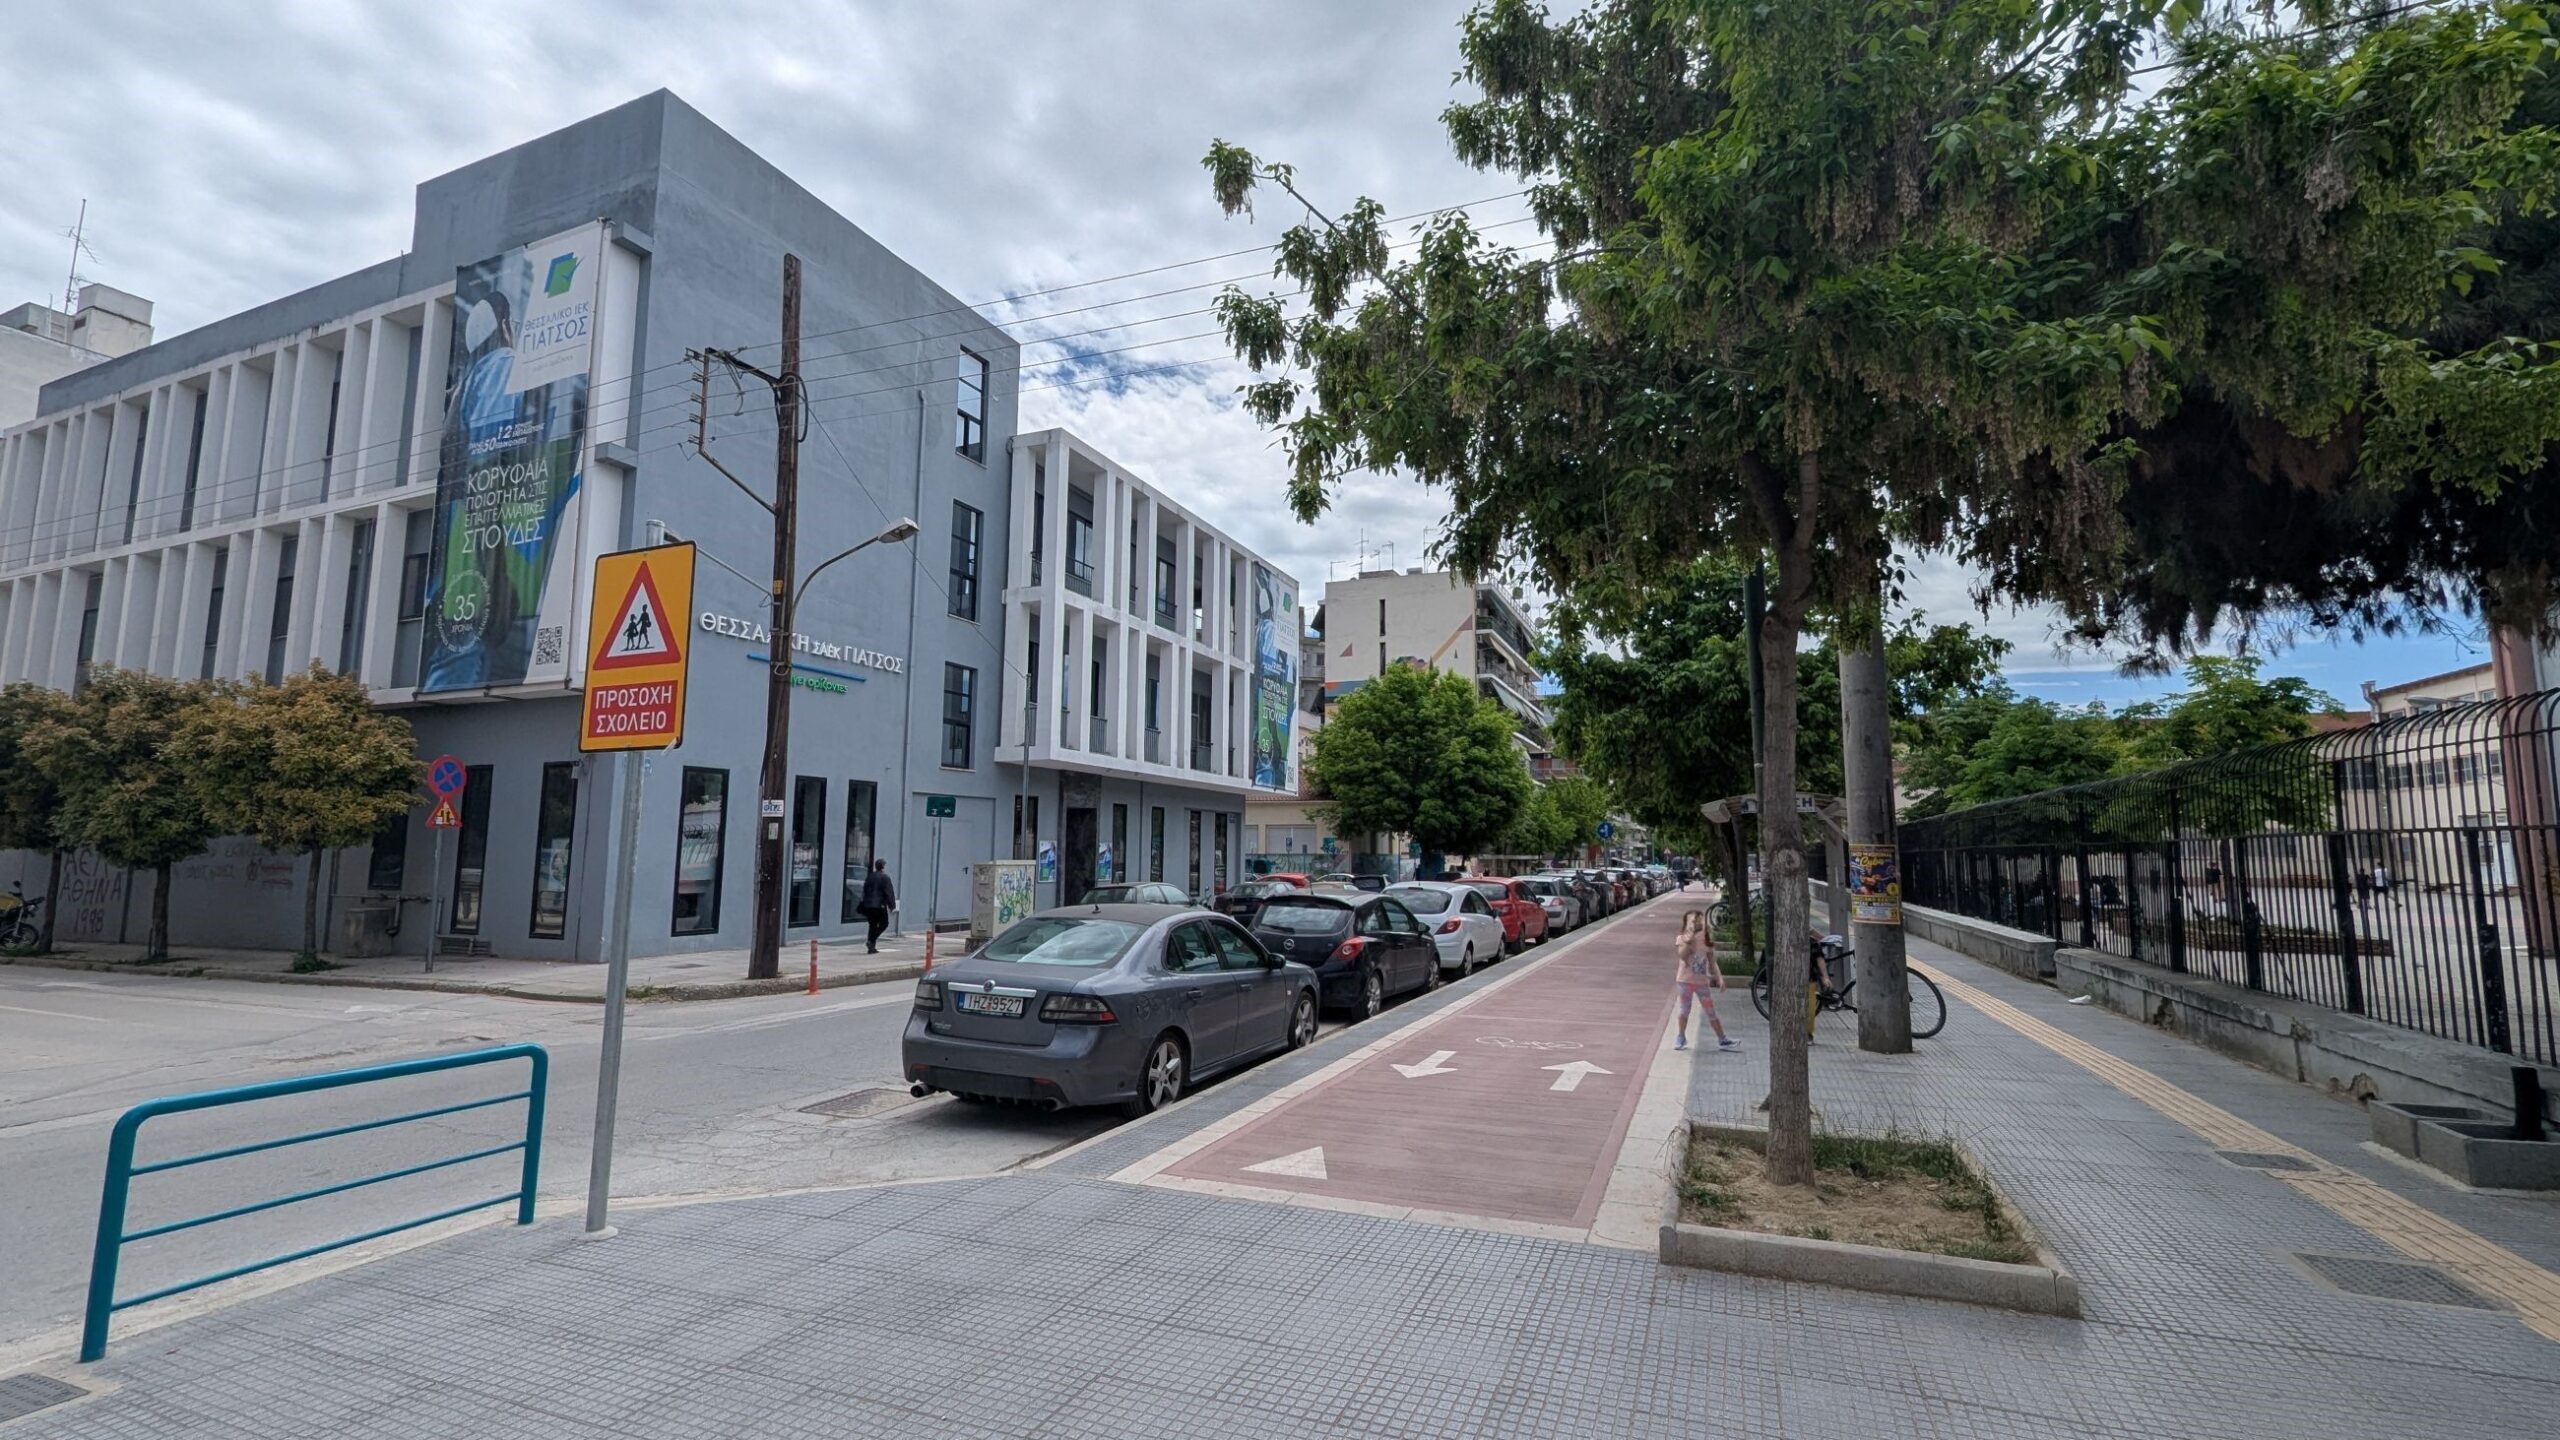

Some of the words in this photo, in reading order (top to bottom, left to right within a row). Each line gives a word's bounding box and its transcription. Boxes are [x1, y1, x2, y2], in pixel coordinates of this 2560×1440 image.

[574, 301, 589, 315] ΙΕΚ
[523, 316, 588, 354] ΓΙΑΤΣΟΣ
[481, 437, 497, 452] 50
[467, 458, 548, 494] ΚΟΡΥΦΑΙΑ
[466, 488, 526, 511] ΠΟΙΟΤΗΤΑ
[528, 480, 548, 498] ΣΤΙΣ
[465, 498, 547, 527] ΕΠΑΓΓΕΛΜΑΤΙΚΕΣ
[462, 516, 545, 553] ΣΠΟΥΔΕΣ
[453, 594, 476, 621] 35
[700, 612, 809, 652] ΘΕΣΣΑΚΗ
[844, 645, 904, 674] ΓΙΑΤΣΟΣ
[595, 685, 673, 710] ΠΡΟΣΟΧΗ
[596, 710, 667, 733] ΣΧΟΛΕΙΟ
[1261, 739, 1270, 753] 35
[58, 872, 122, 905] ΑΘΗΝΑ
